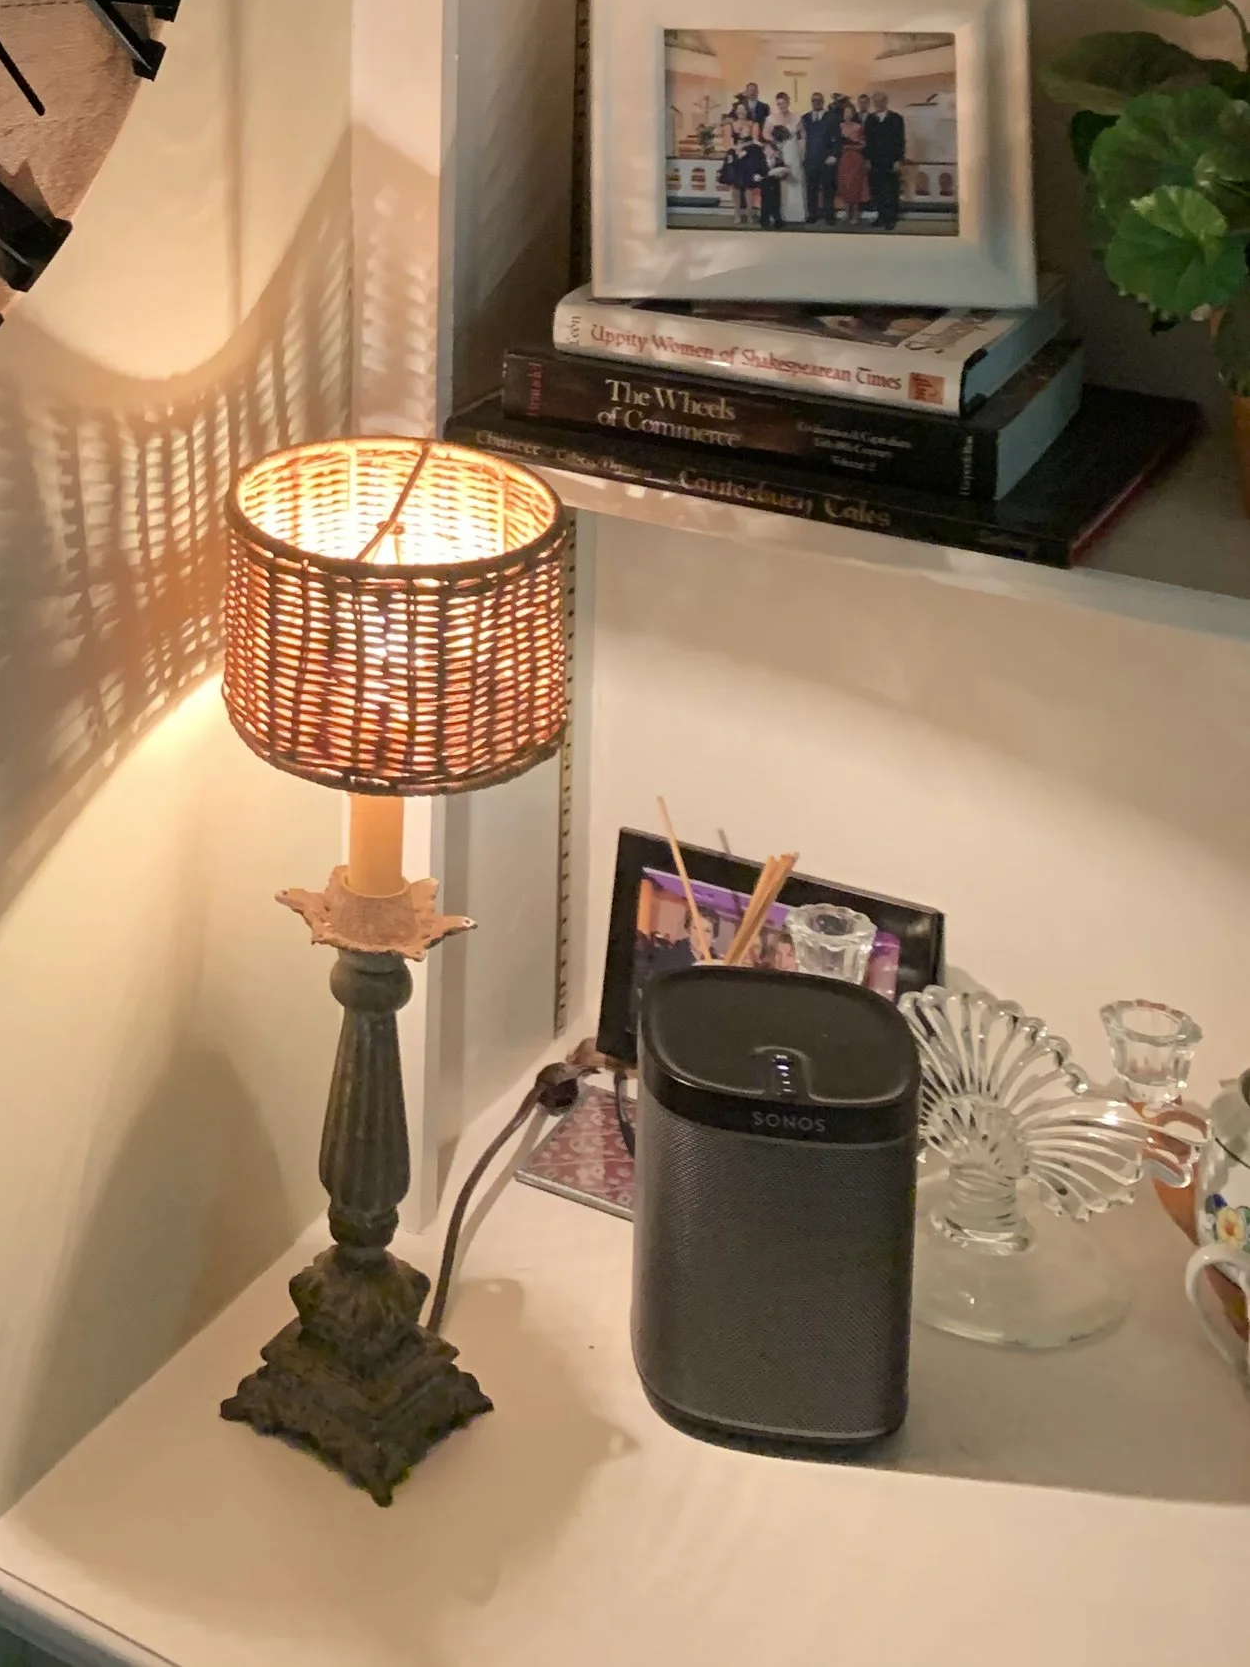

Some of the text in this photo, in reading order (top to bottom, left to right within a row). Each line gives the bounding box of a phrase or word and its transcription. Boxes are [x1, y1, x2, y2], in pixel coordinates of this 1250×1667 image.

[590, 324, 649, 353] Uppity
[651, 334, 714, 360] Women
[719, 346, 740, 365] of
[741, 348, 852, 383] Shakespearean
[855, 366, 902, 391] Times
[605, 378, 737, 421] The Wheels
[597, 406, 742, 448] of Commerce
[678, 467, 893, 527] Canterbury Tales
[752, 1110, 827, 1133] SONOS
